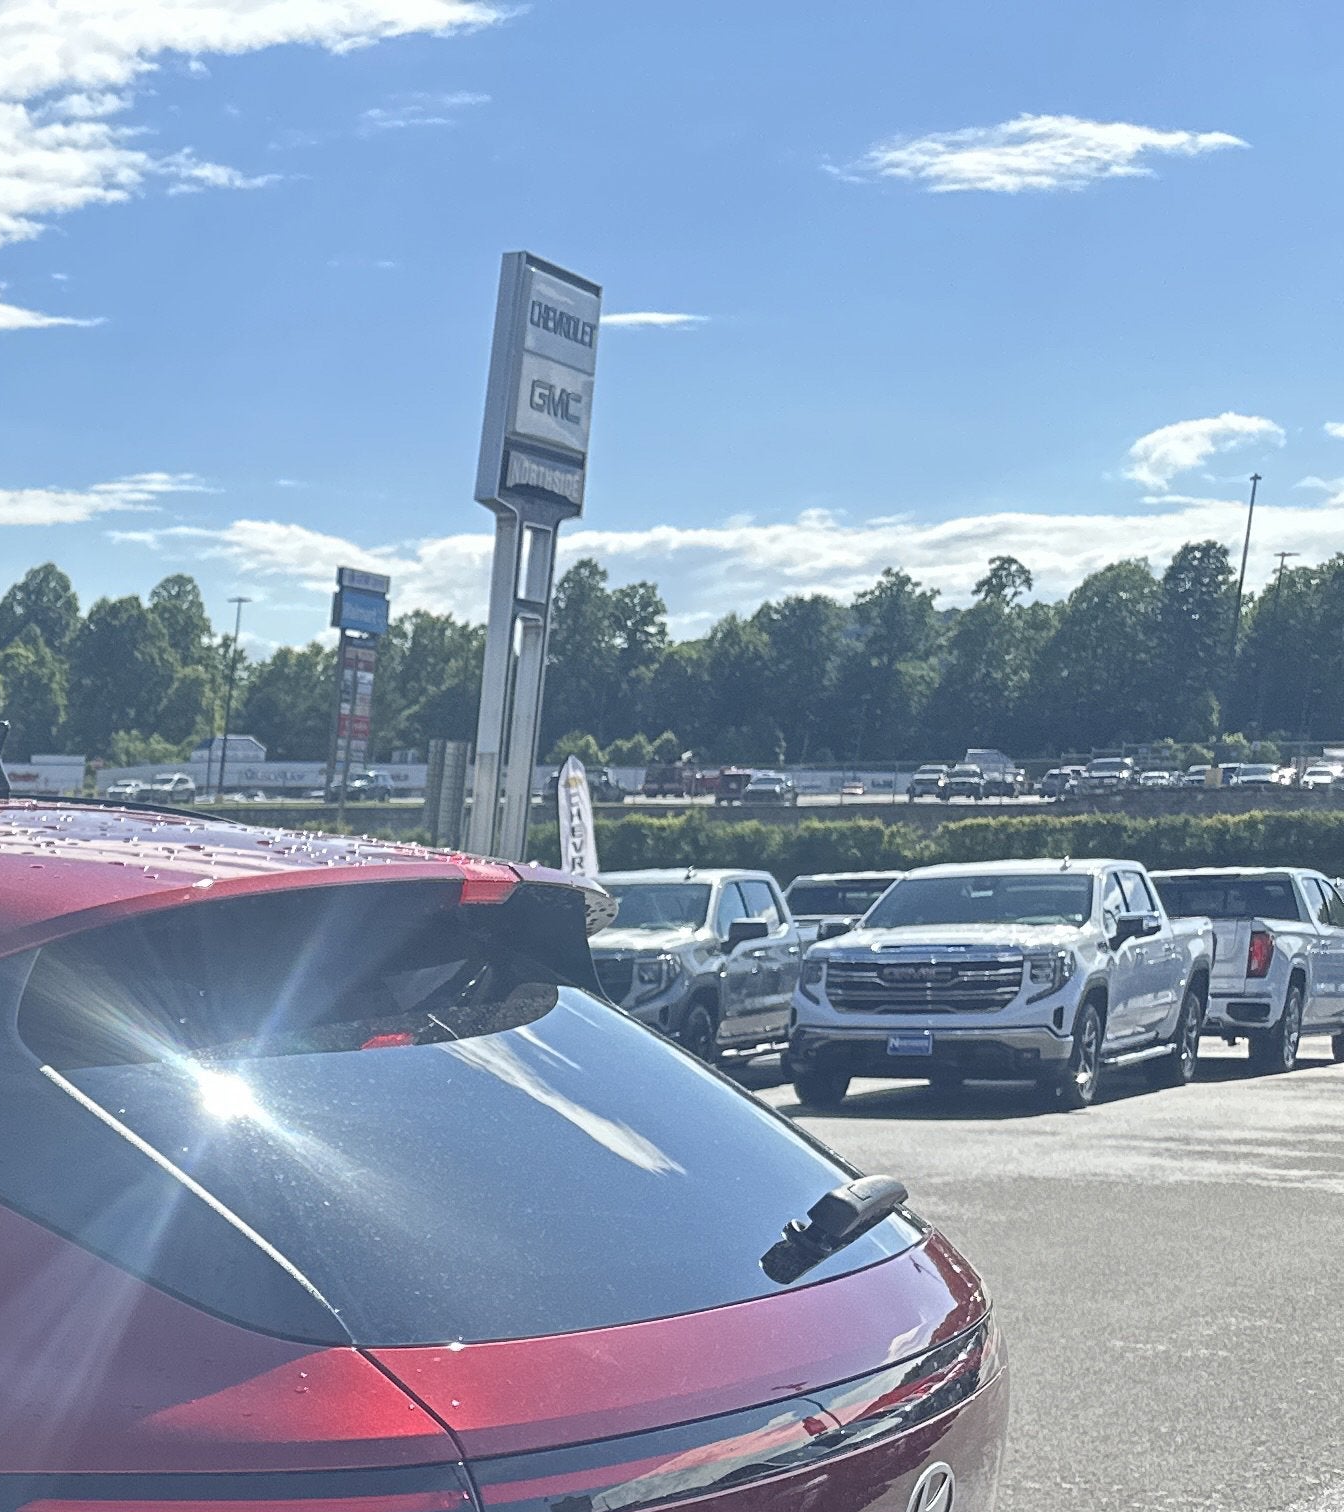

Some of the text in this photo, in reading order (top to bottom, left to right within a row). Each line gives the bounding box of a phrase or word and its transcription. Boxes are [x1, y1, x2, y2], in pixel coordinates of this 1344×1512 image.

[530, 300, 596, 349] CHEVROLET
[529, 378, 582, 425] GMC
[507, 456, 581, 499] NORTHSIDE
